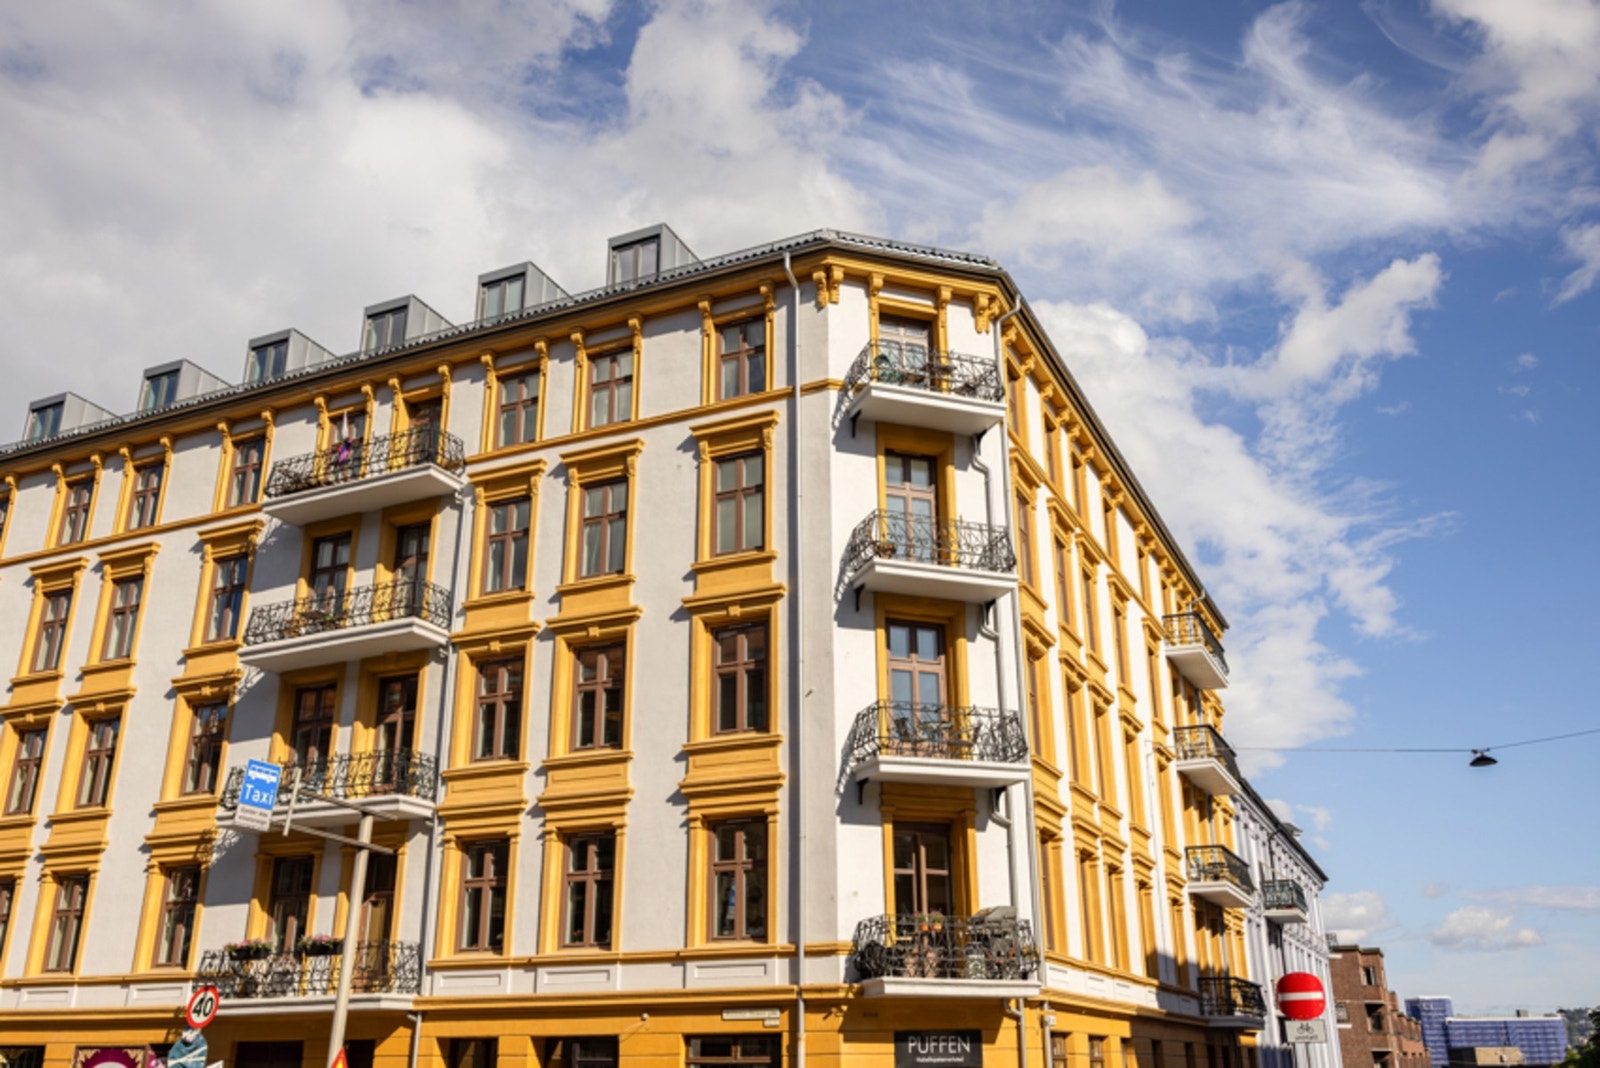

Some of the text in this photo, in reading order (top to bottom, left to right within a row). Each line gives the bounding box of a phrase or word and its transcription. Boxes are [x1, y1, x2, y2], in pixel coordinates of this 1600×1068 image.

[245, 783, 274, 805] Taxi
[192, 997, 214, 1017] 40
[908, 1036, 970, 1053] PUFFEN
